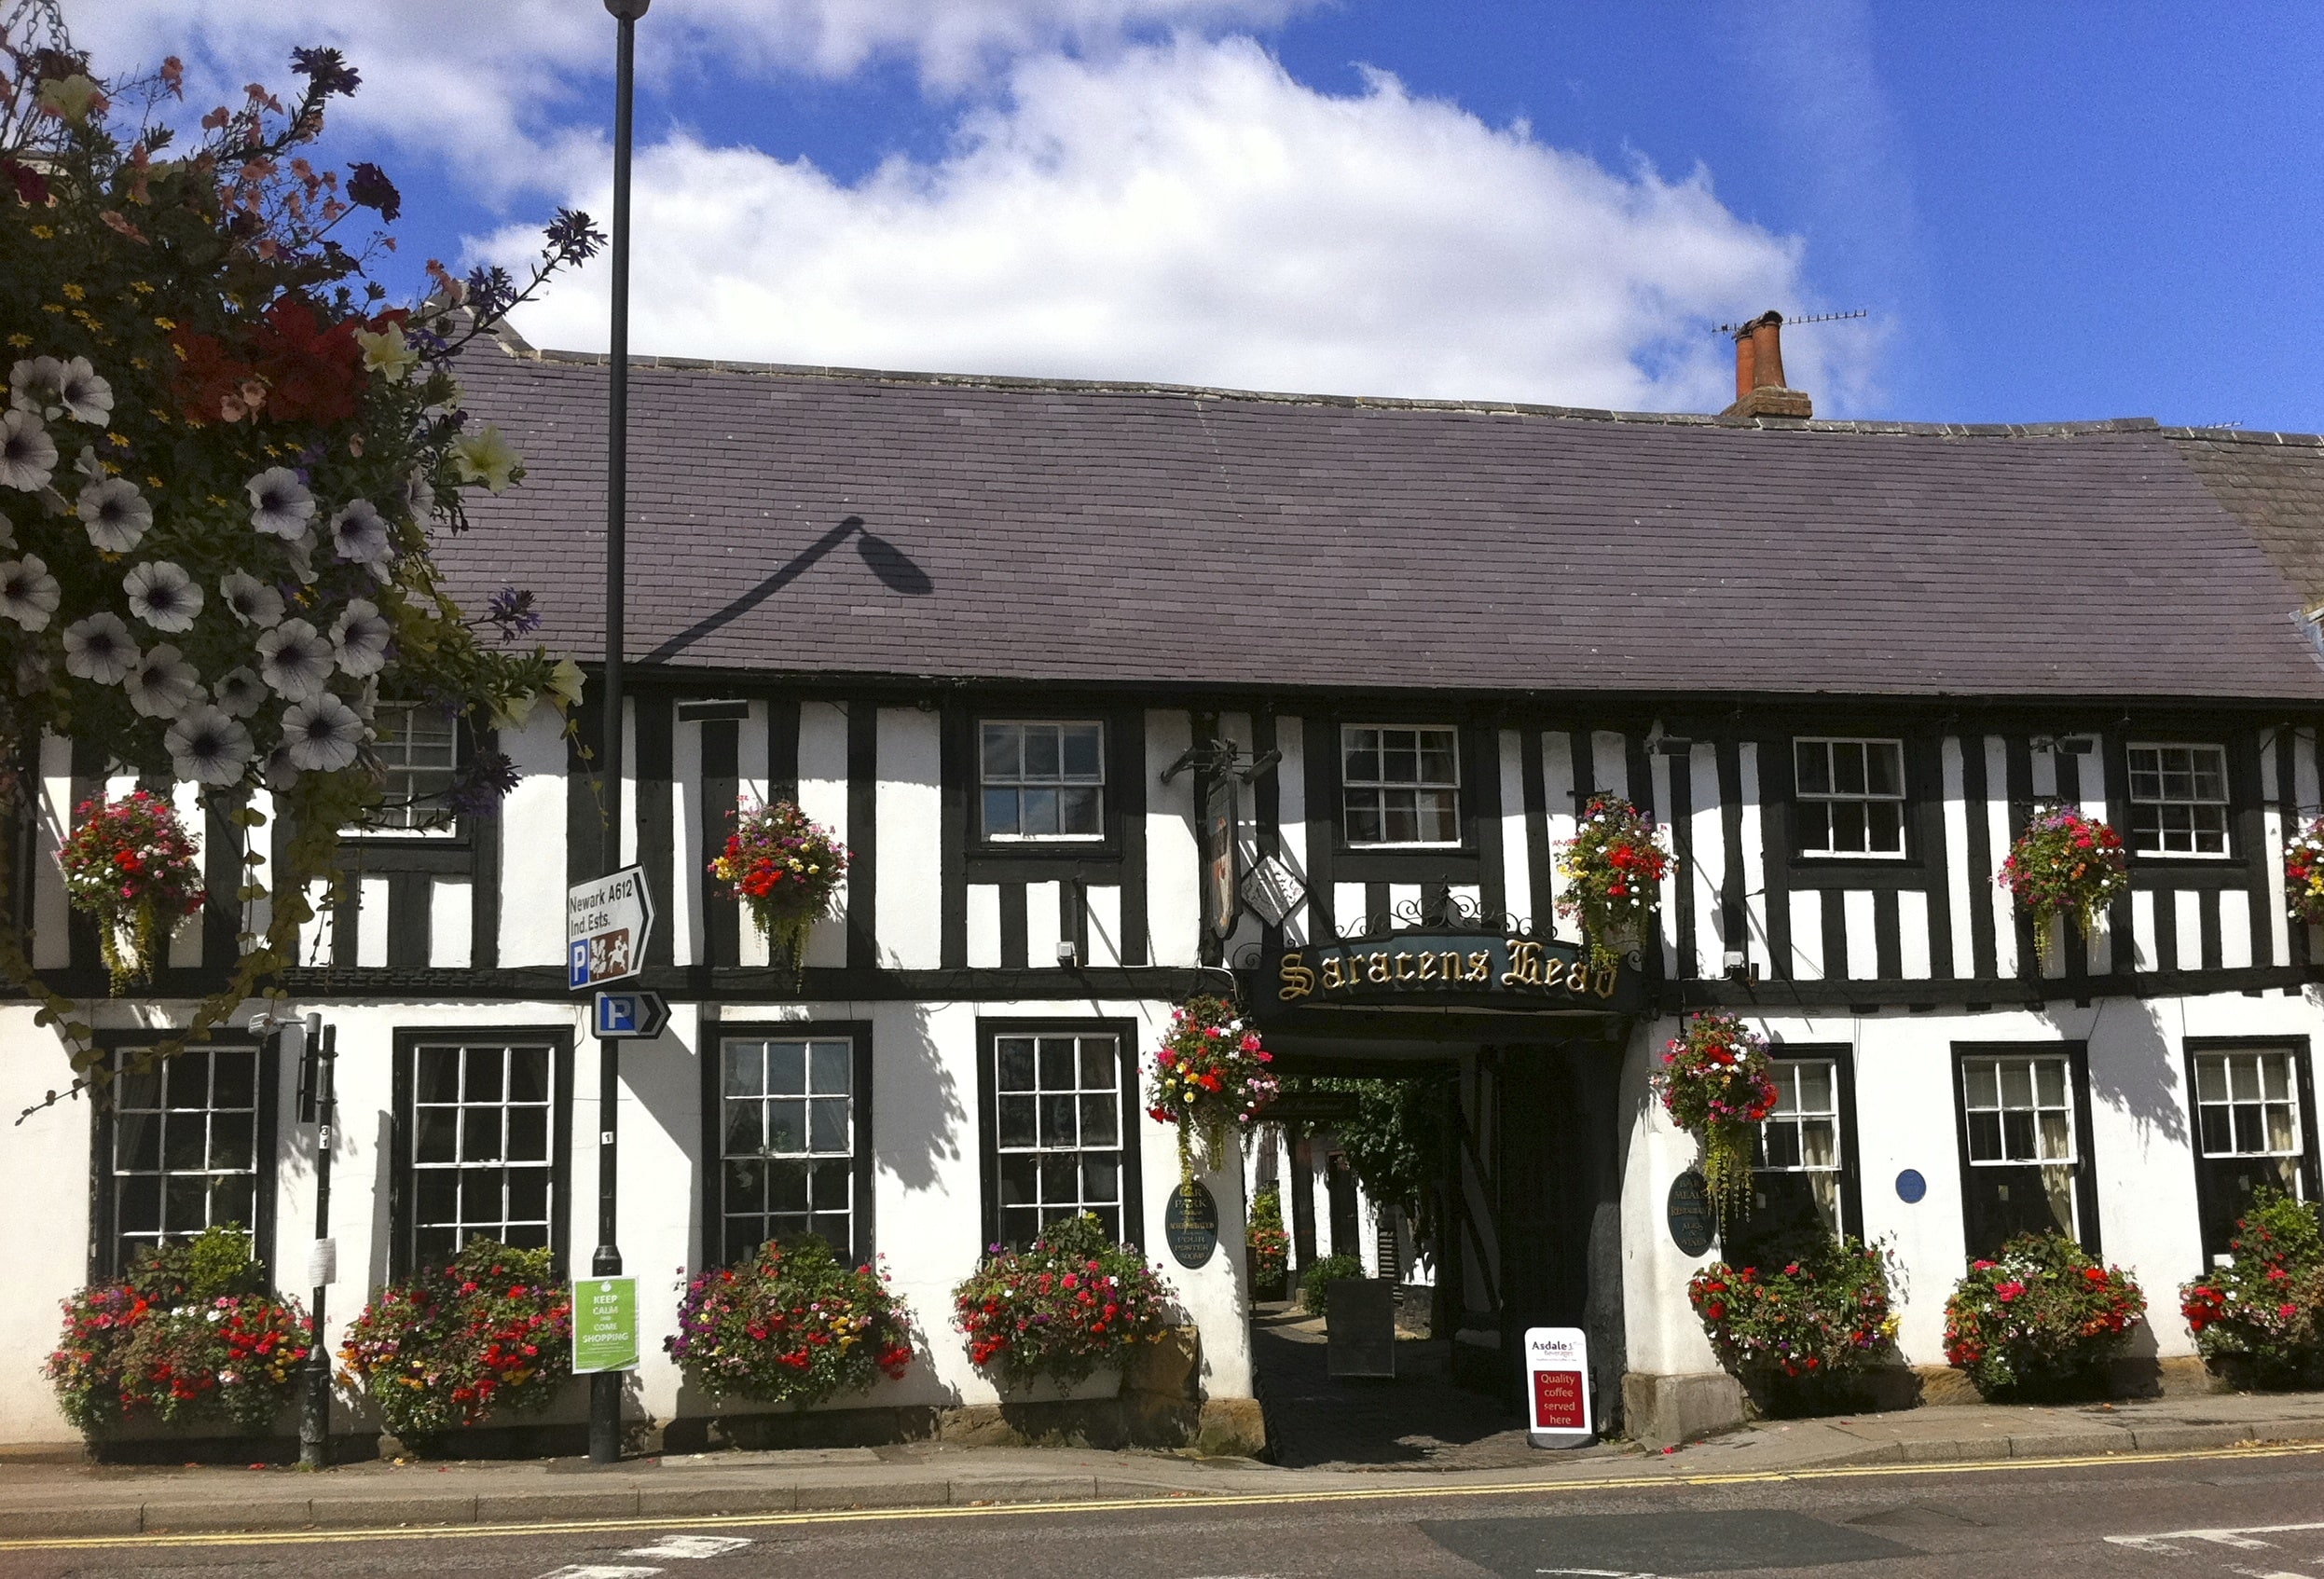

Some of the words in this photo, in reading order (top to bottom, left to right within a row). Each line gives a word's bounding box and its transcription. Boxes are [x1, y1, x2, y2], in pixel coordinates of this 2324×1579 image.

[571, 888, 605, 913] Newark
[609, 879, 632, 902] A612
[1278, 948, 1490, 1001] Saracens
[1501, 939, 1617, 999] Head
[594, 1295, 618, 1304] KEEP
[593, 1306, 619, 1315] CALM
[594, 1323, 617, 1331] COME
[582, 1332, 629, 1343] SHOPPING
[1532, 1341, 1567, 1351] Asdale
[1540, 1374, 1575, 1385] Quality
[1544, 1387, 1574, 1397] coffee
[1544, 1401, 1575, 1411] served
[1549, 1415, 1572, 1424] here
